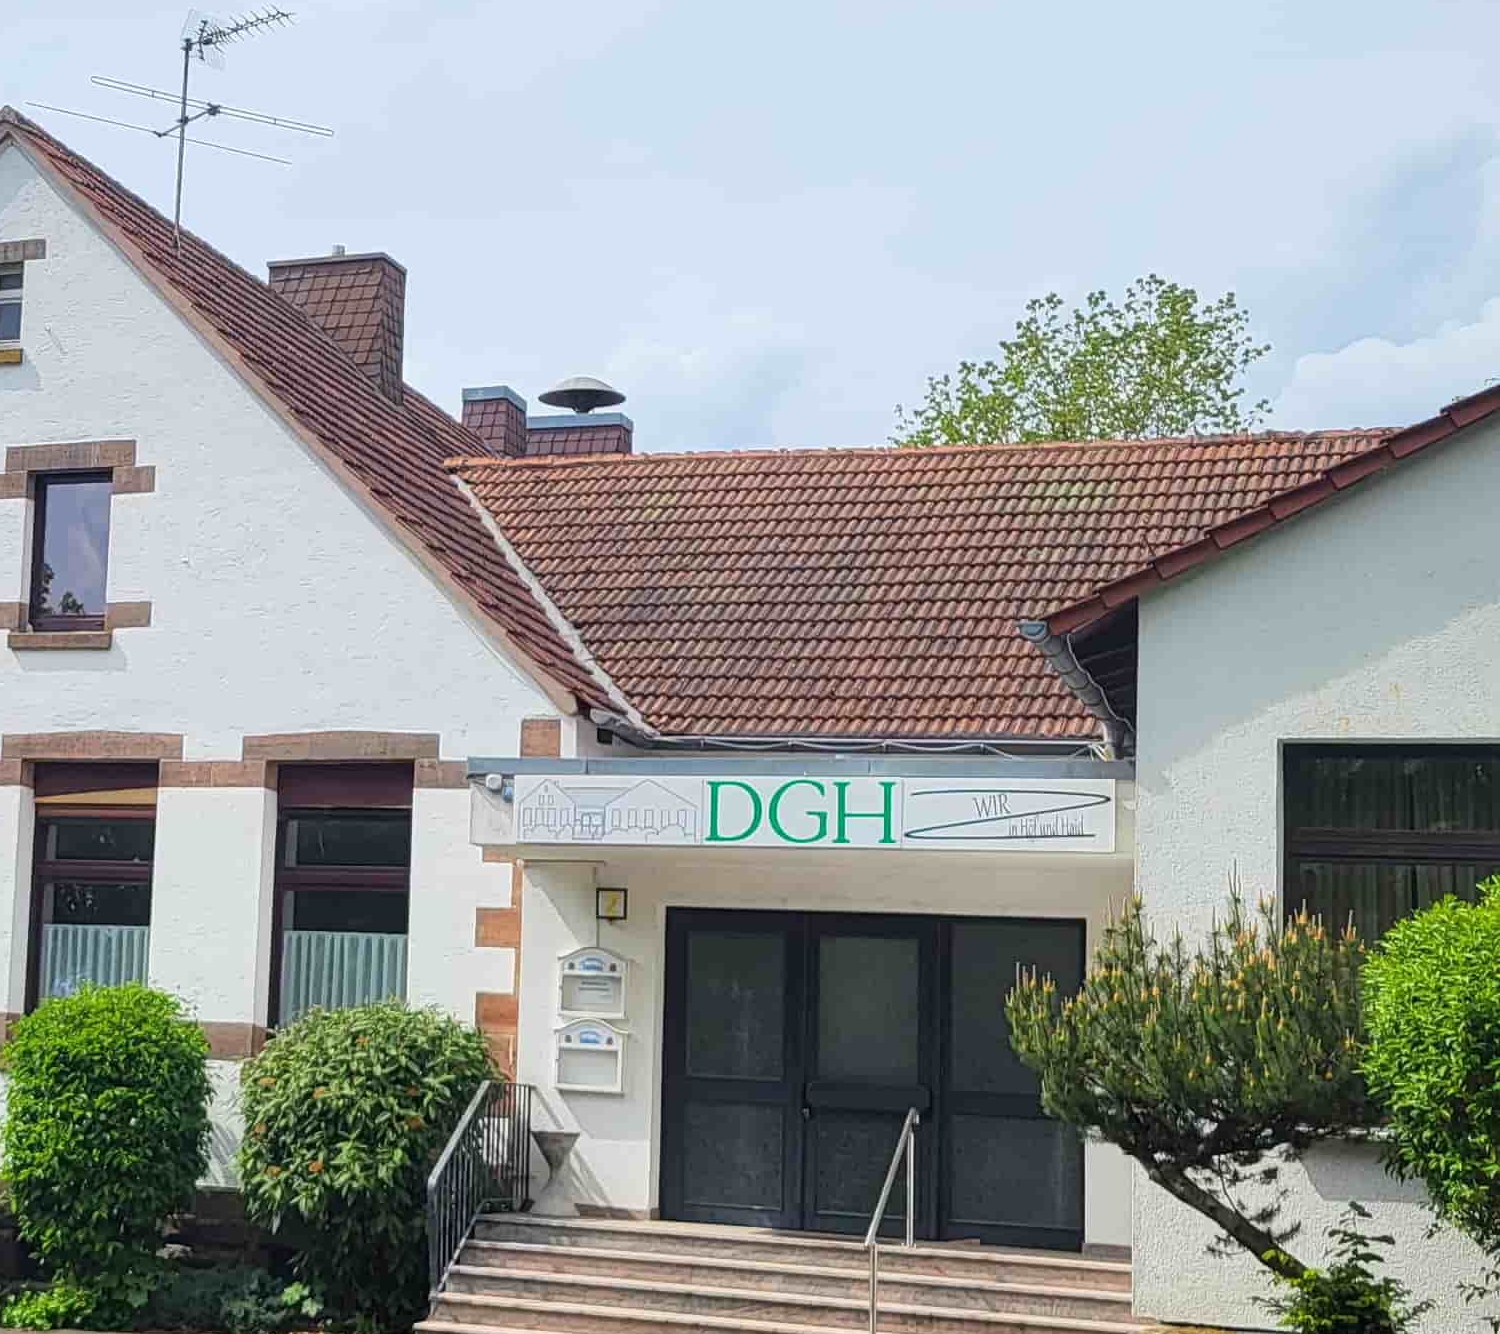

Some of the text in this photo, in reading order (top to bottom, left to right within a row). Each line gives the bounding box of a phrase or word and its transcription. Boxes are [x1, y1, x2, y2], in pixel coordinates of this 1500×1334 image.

[705, 779, 897, 844] DGH
[973, 793, 1011, 818] WIR
[1008, 817, 1018, 836] in
[1040, 813, 1059, 836] und
